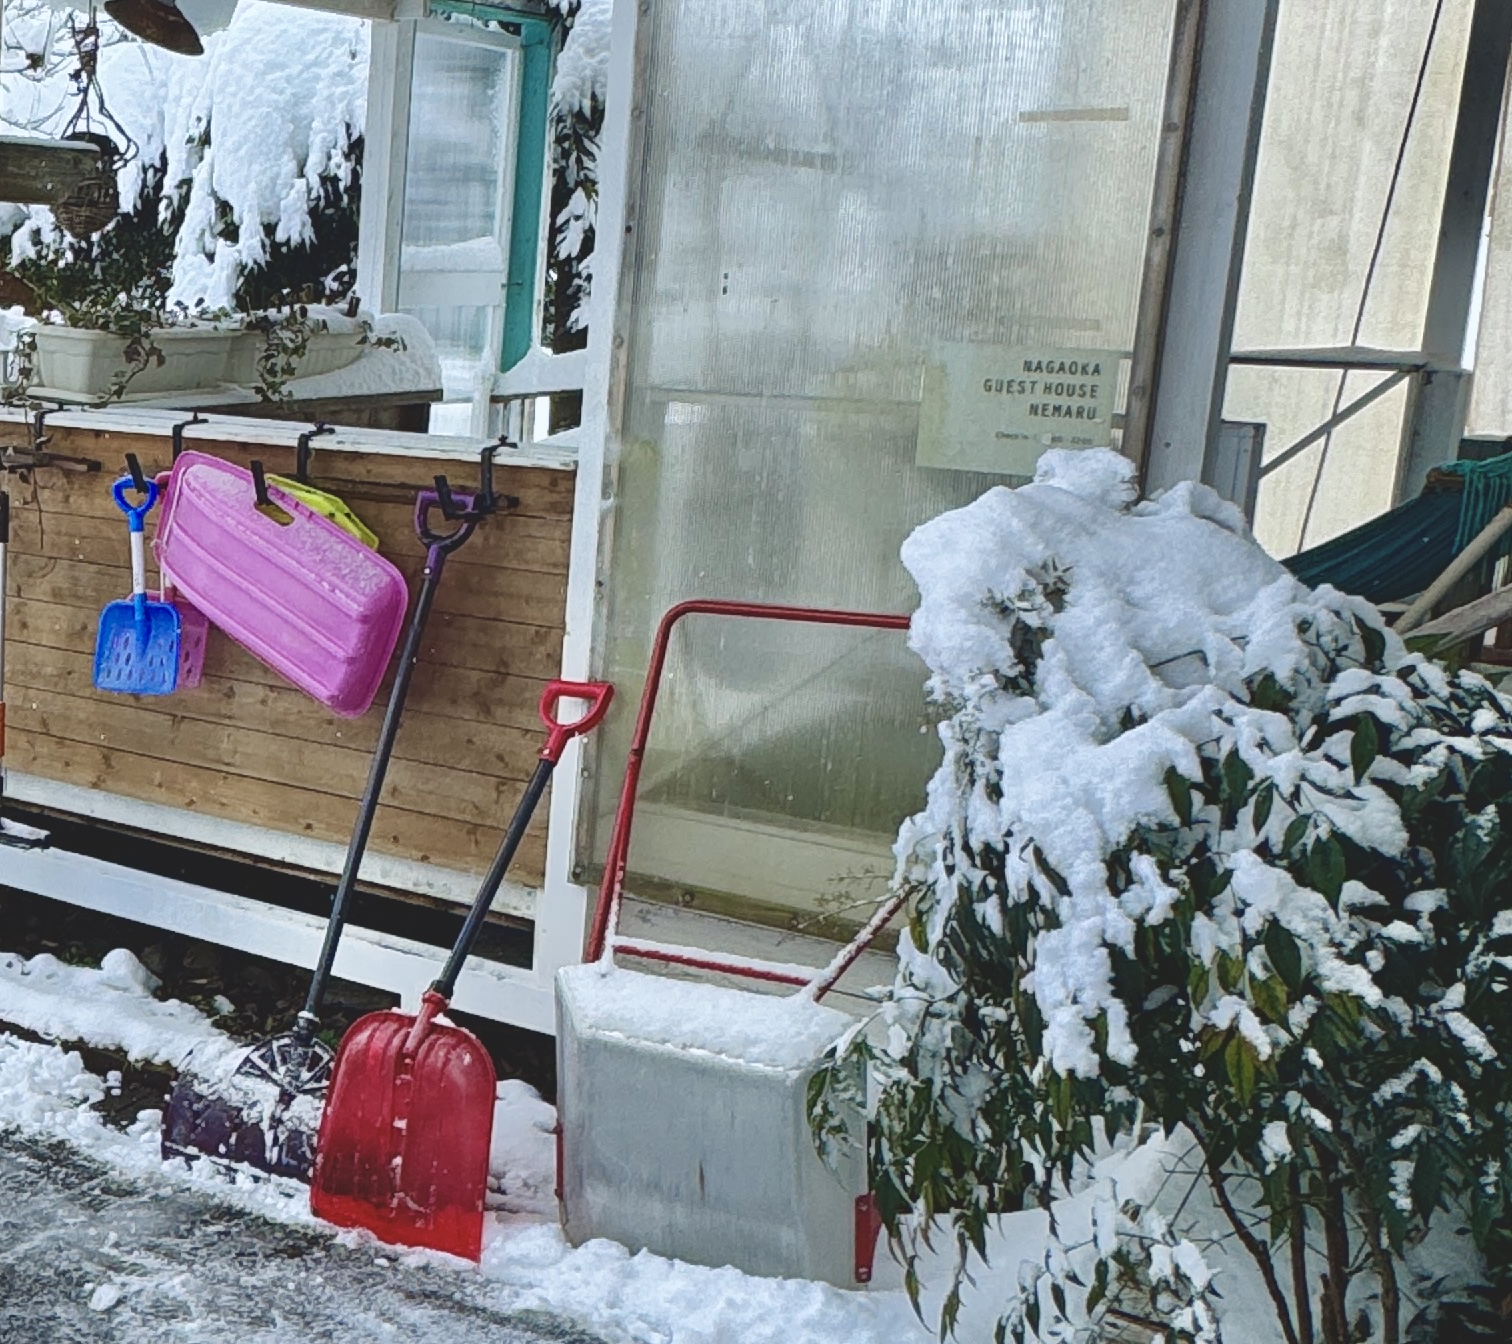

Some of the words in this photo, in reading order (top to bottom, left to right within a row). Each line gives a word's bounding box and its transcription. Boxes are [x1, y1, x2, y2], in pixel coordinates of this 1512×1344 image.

[1022, 359, 1102, 376] NAGAOKA
[982, 378, 1038, 395] GUEST
[1042, 382, 1100, 398] HOUSE
[1028, 402, 1098, 420] NEMARU
